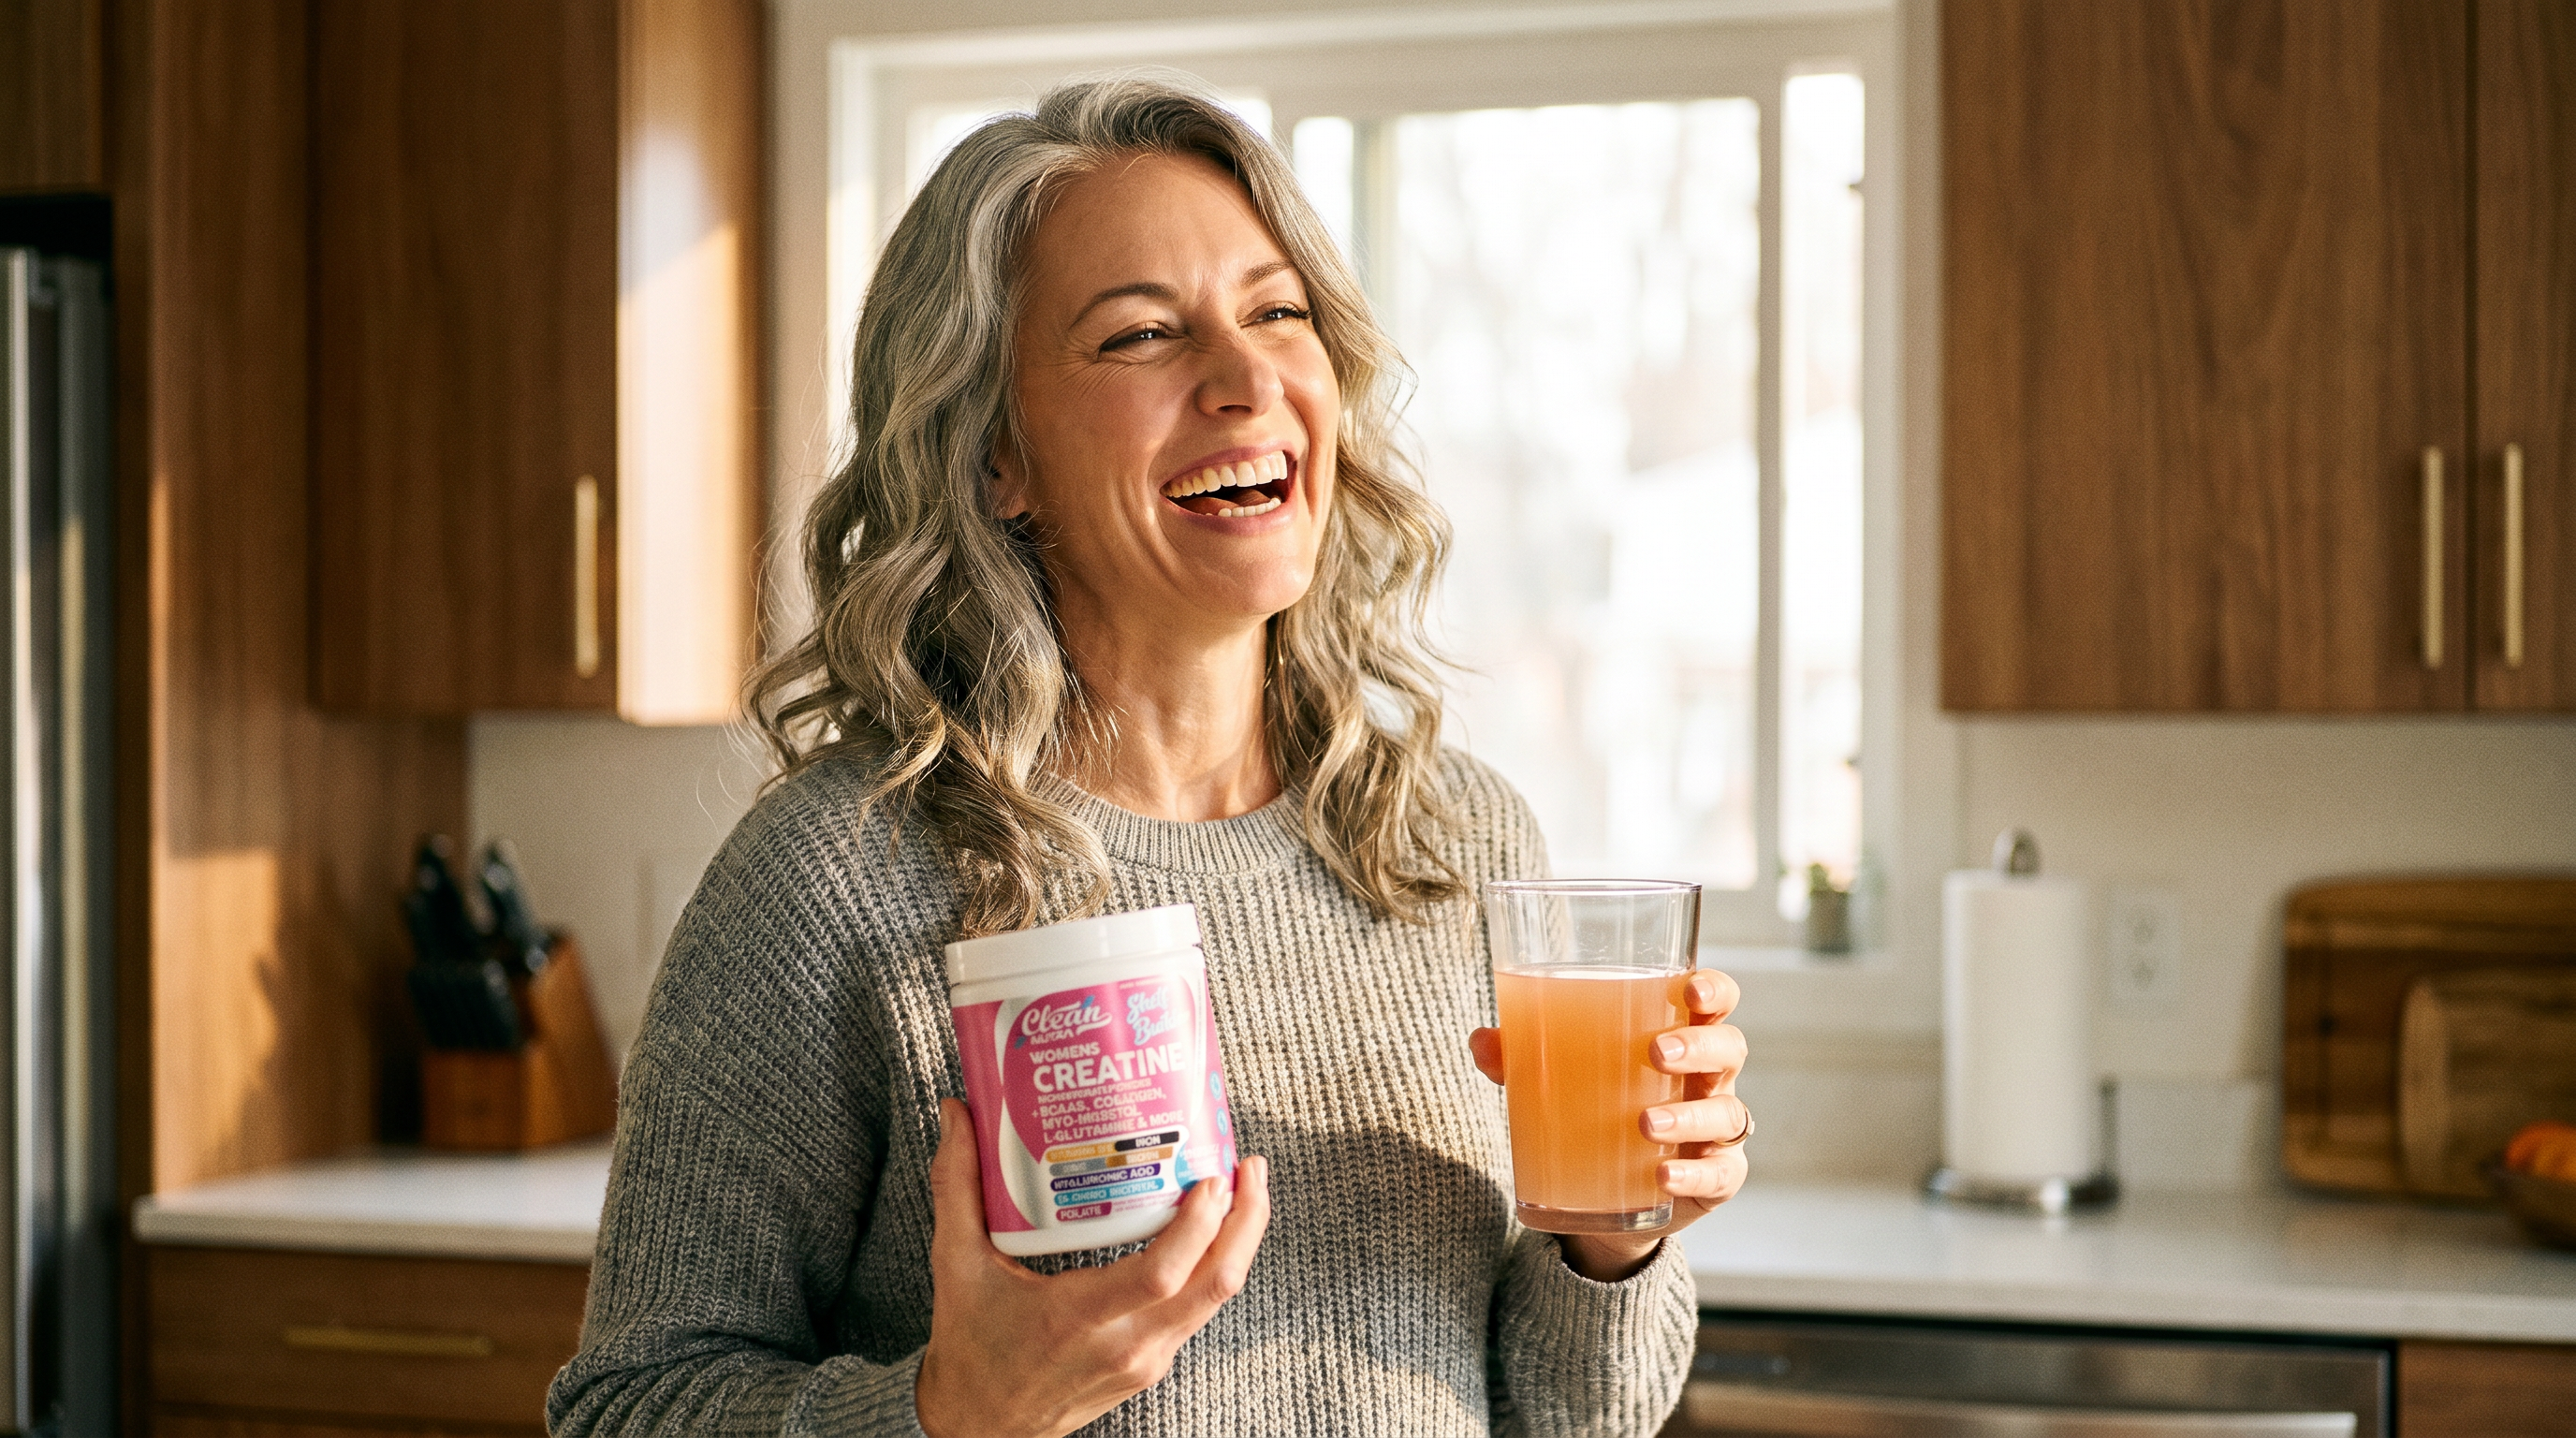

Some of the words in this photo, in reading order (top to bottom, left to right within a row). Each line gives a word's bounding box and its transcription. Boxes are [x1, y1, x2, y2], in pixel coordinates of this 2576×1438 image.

[1022, 1001, 1112, 1035] Clean
[1030, 1041, 1101, 1064] WOMENS
[1033, 1042, 1186, 1093] CREATINE
[1137, 1117, 1149, 1128] &
